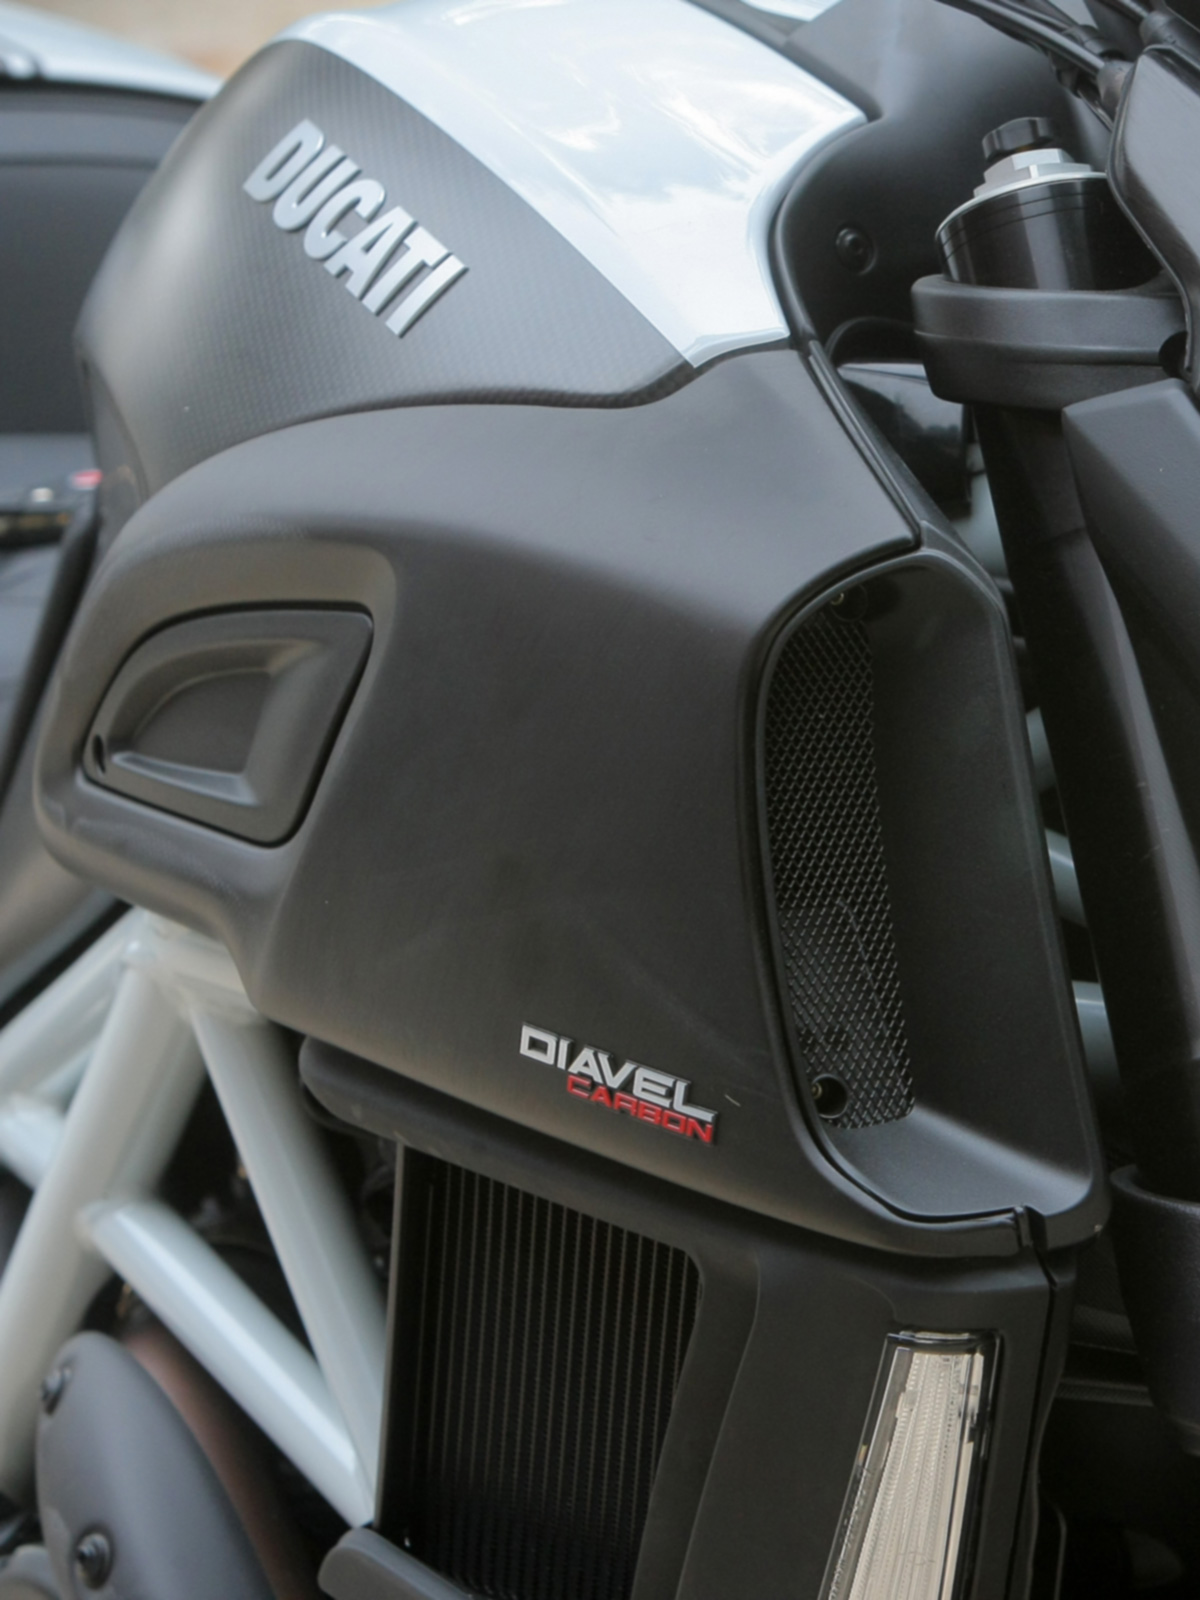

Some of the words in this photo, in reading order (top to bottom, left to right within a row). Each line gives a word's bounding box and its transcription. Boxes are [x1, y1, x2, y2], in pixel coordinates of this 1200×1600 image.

[242, 118, 468, 338] DUCATI
[520, 1022, 718, 1124] DIAVEL
[567, 1074, 714, 1144] CARBON
